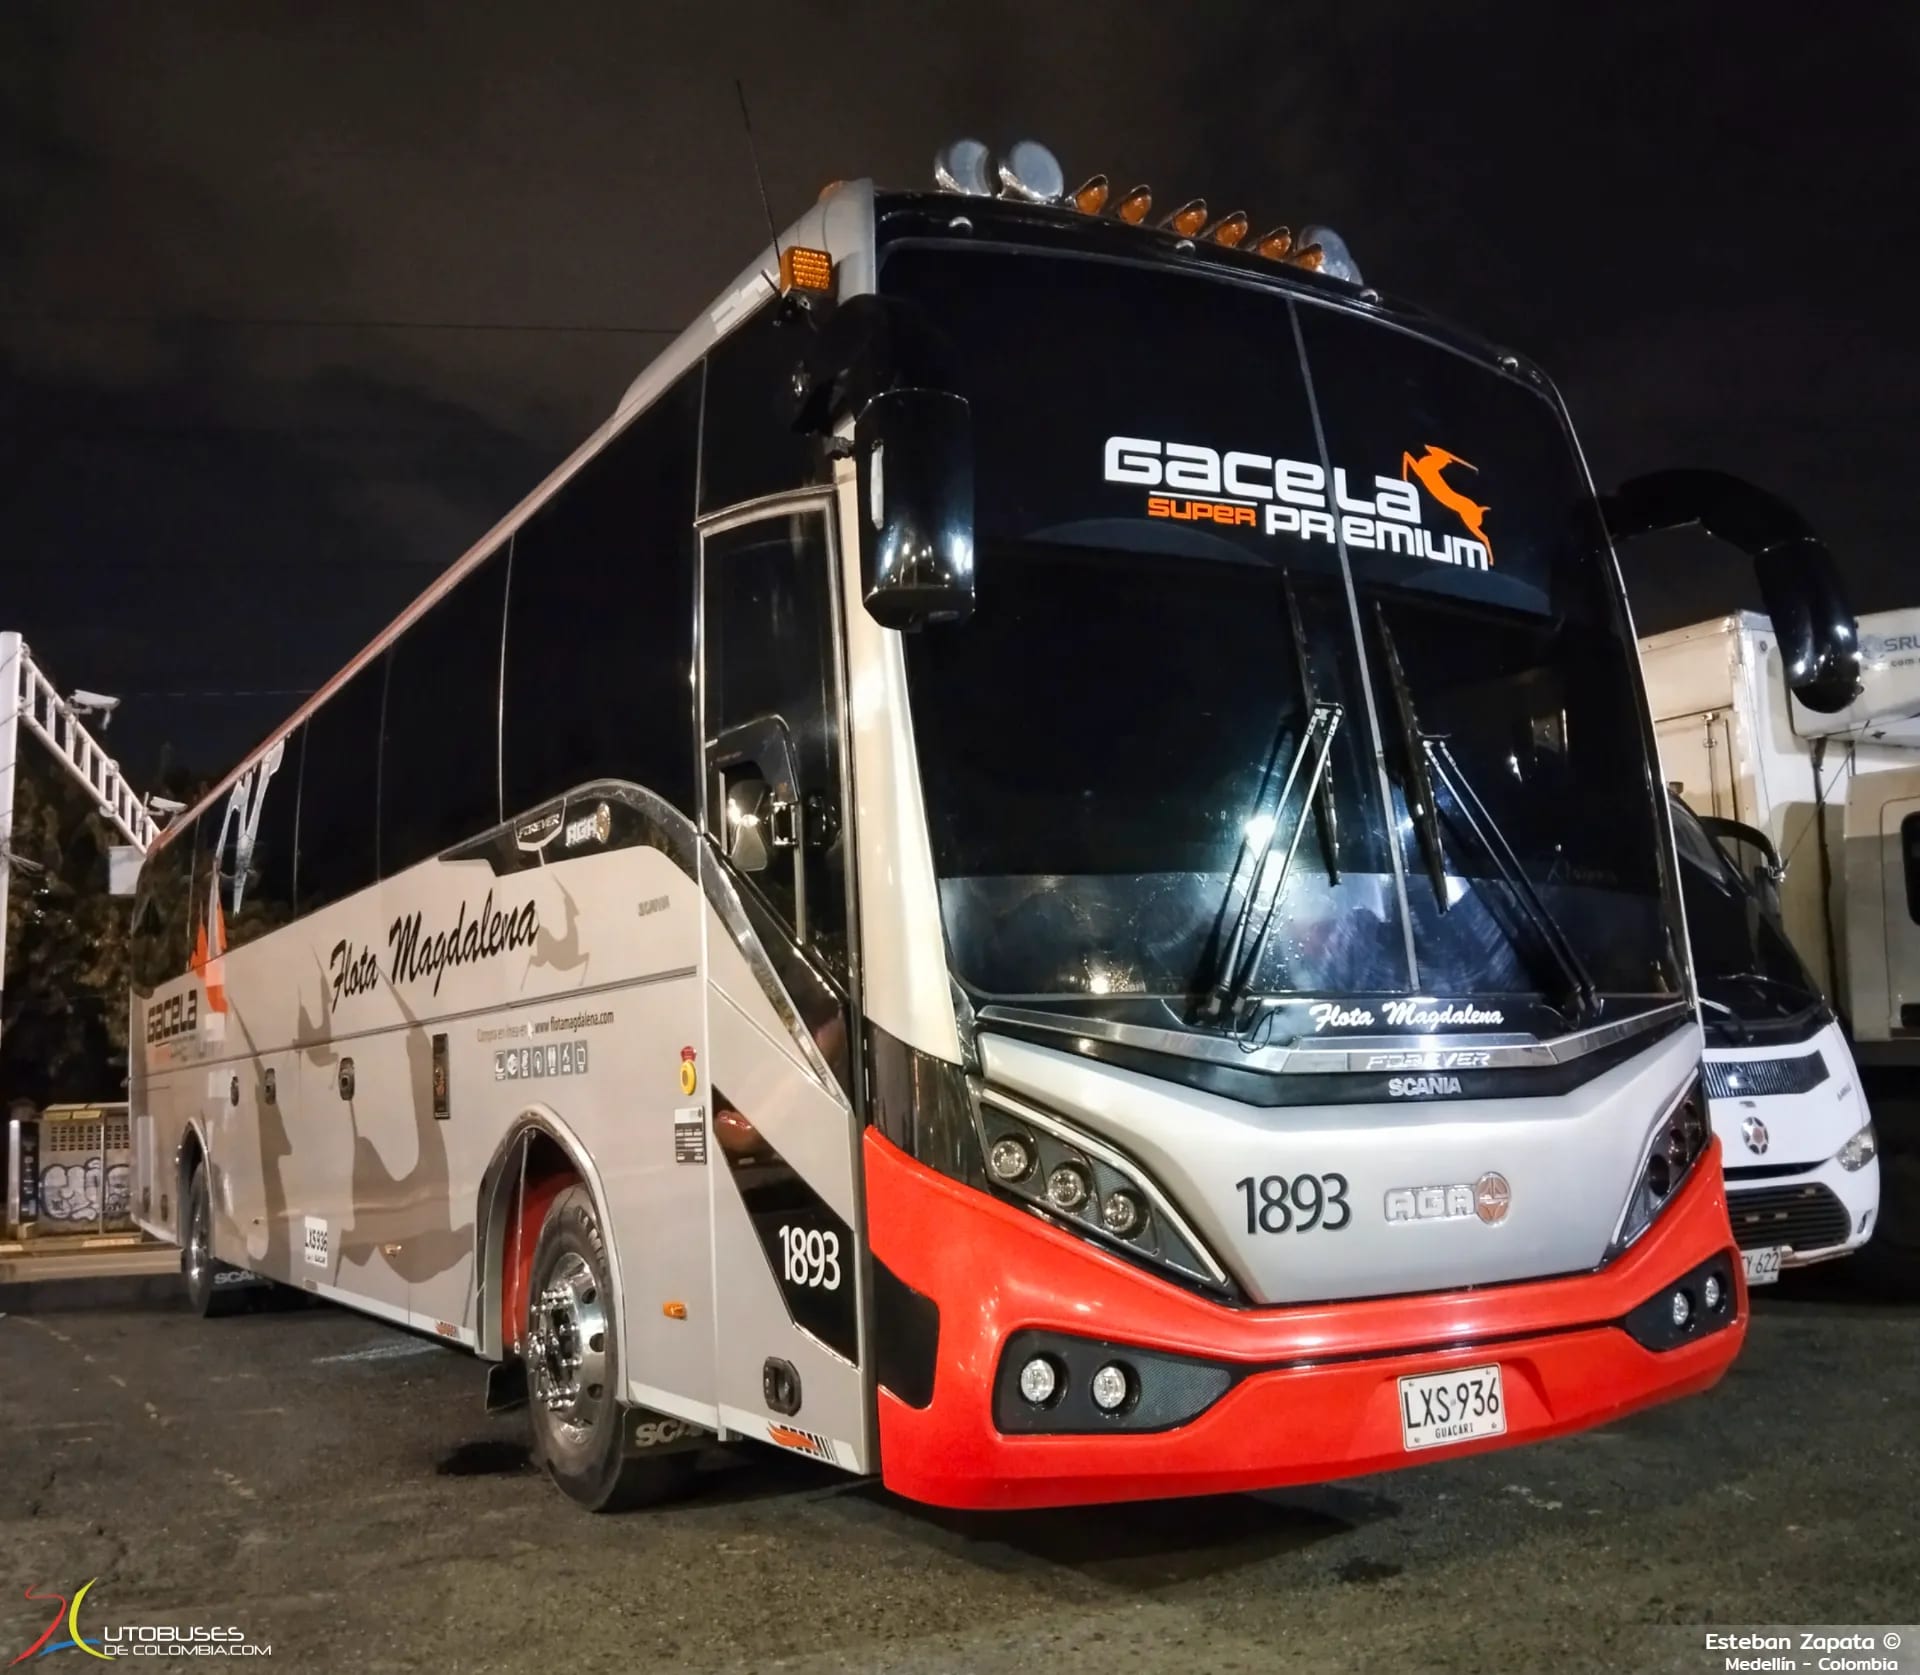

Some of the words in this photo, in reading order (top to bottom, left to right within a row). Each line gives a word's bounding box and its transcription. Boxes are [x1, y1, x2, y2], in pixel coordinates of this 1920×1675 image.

[565, 813, 598, 847] AGA
[329, 938, 379, 1014] Flota
[388, 887, 540, 997] Magdalena
[1308, 1002, 1375, 1032] Flota
[1381, 1001, 1505, 1031] Magdalena
[1365, 1052, 1491, 1070] FOREVER
[1388, 1077, 1462, 1097] SCANIA
[1235, 1172, 1352, 1235] 1893
[1383, 1182, 1476, 1226] AGA
[779, 1224, 841, 1290] 1893
[1434, 1422, 1474, 1439] GUACARI
